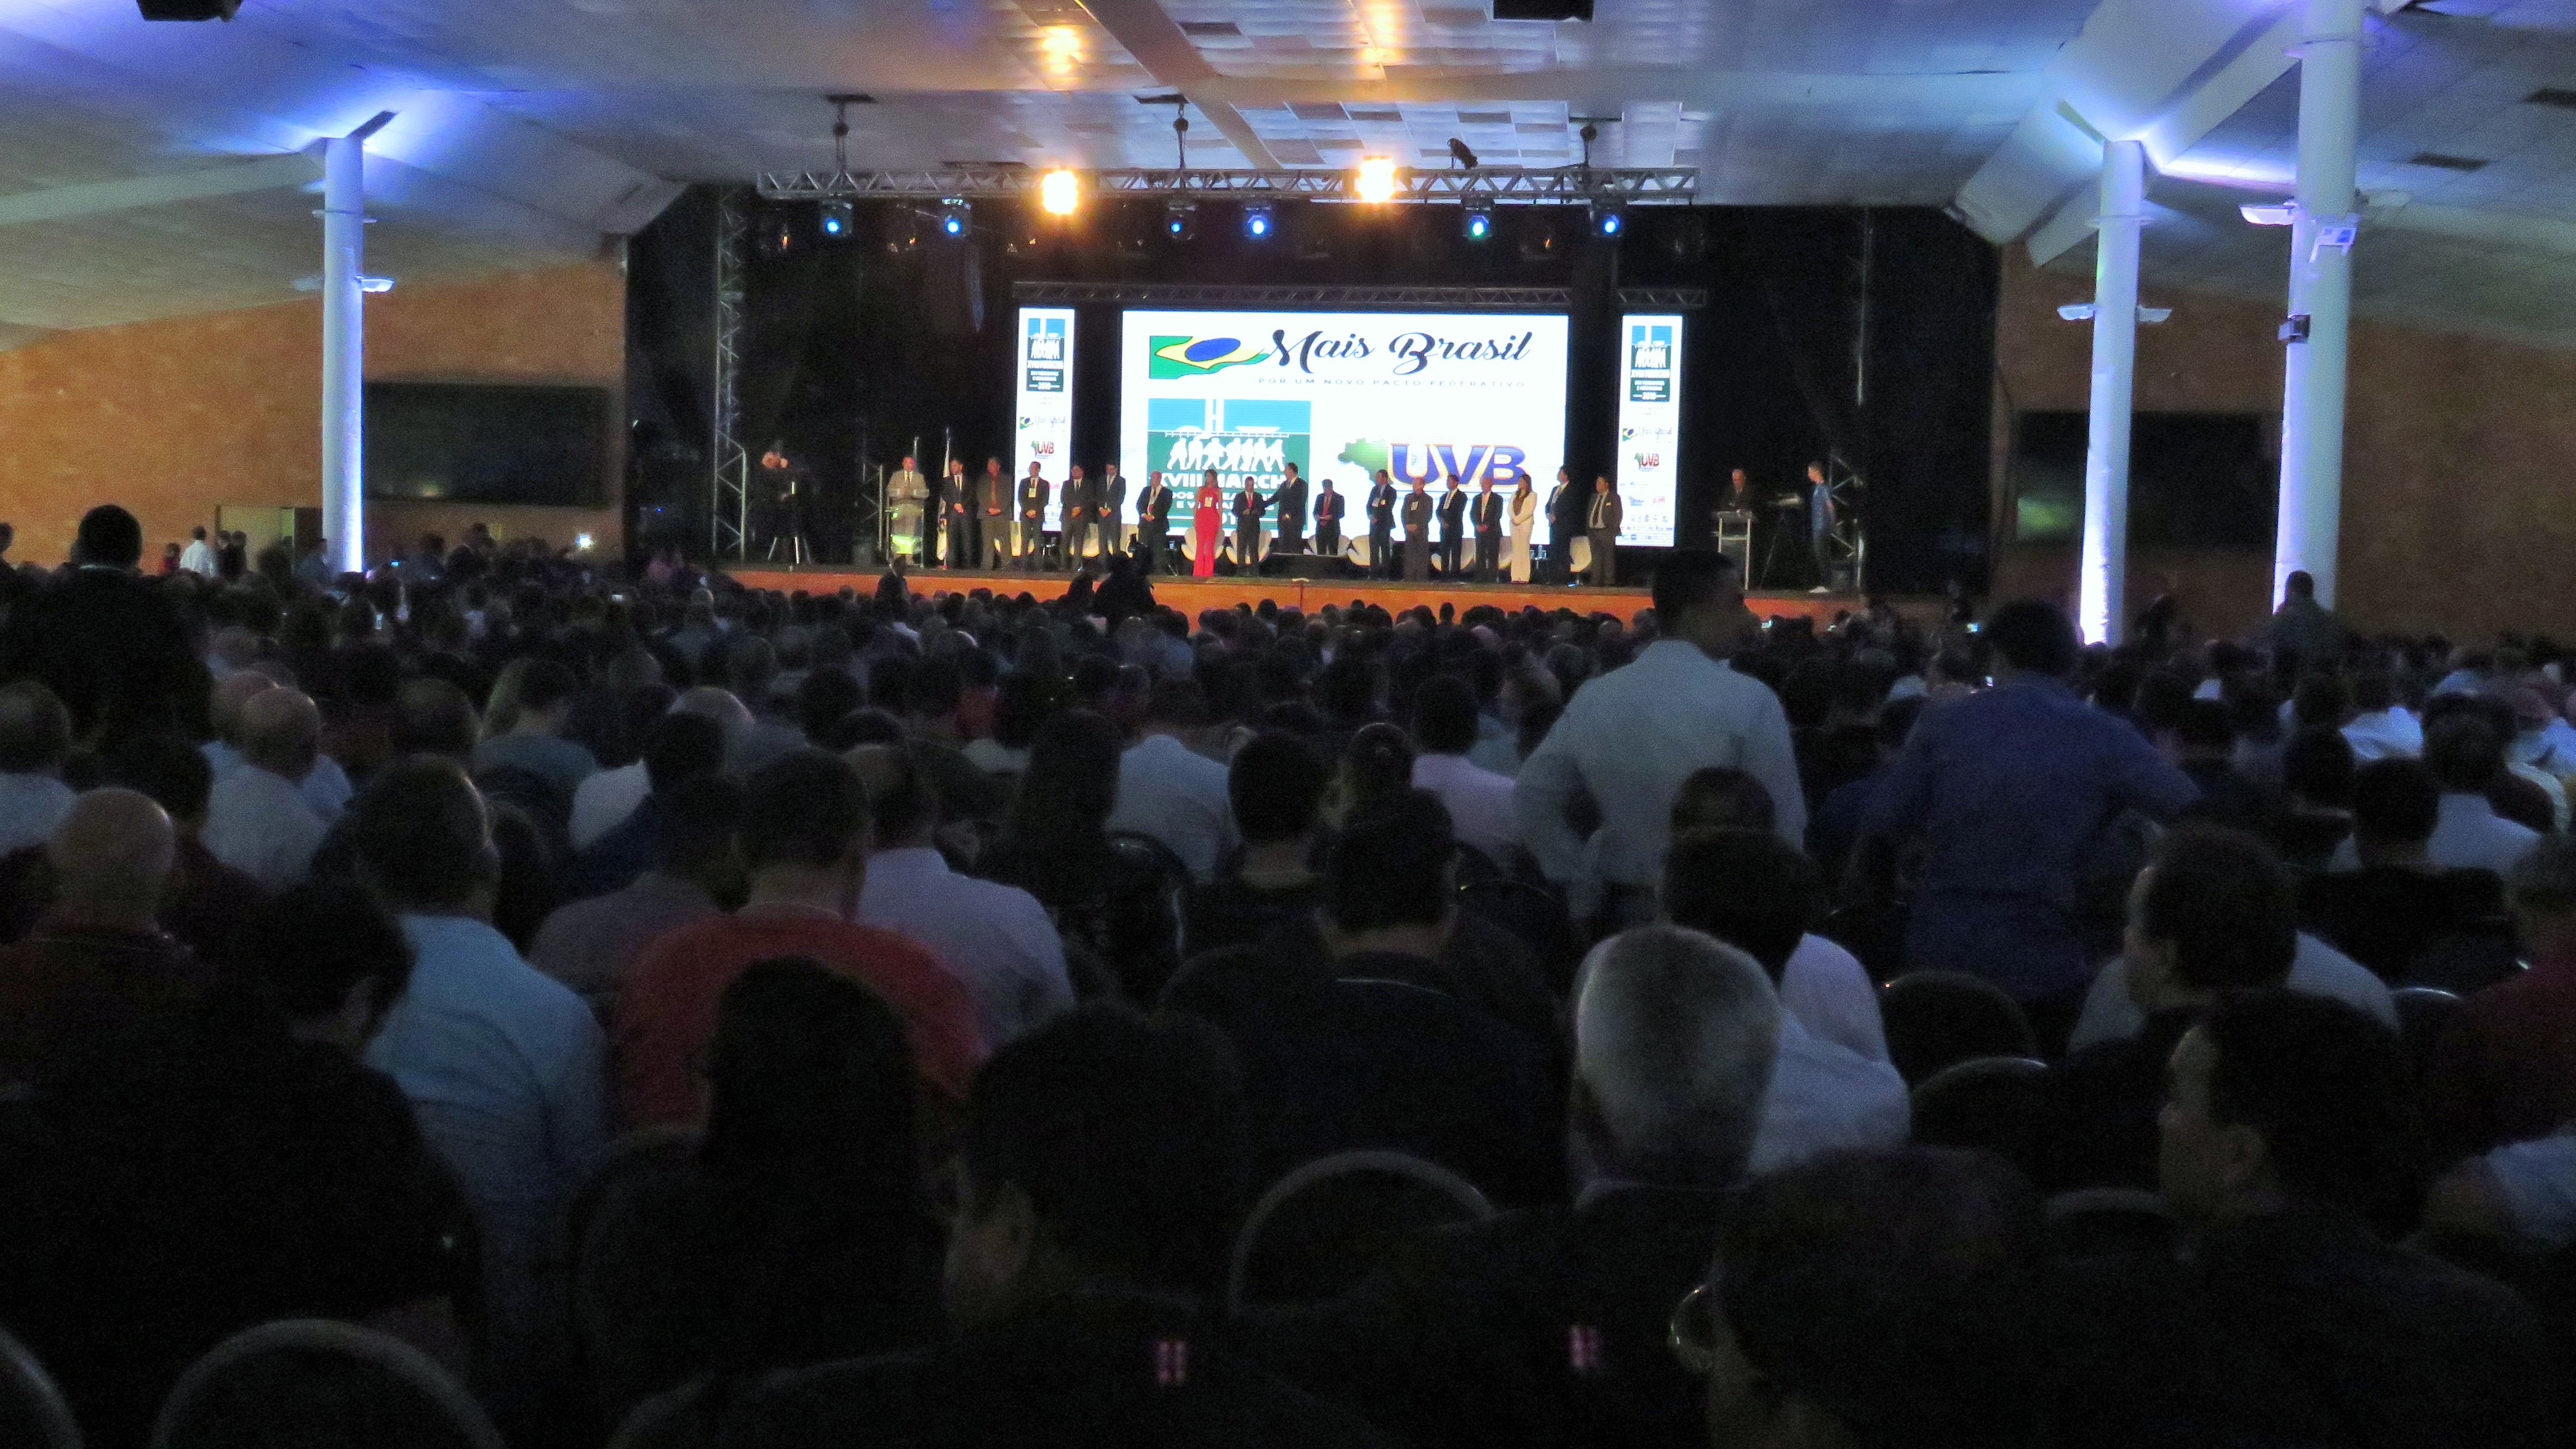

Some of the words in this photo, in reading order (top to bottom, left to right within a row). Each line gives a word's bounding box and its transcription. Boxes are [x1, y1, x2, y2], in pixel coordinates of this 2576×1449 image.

[1272, 329, 1375, 374] Mais
[1389, 332, 1533, 375] Brasil
[1037, 441, 1054, 454] UVB
[1641, 453, 1660, 467] UVB
[1389, 443, 1528, 487] UVB
